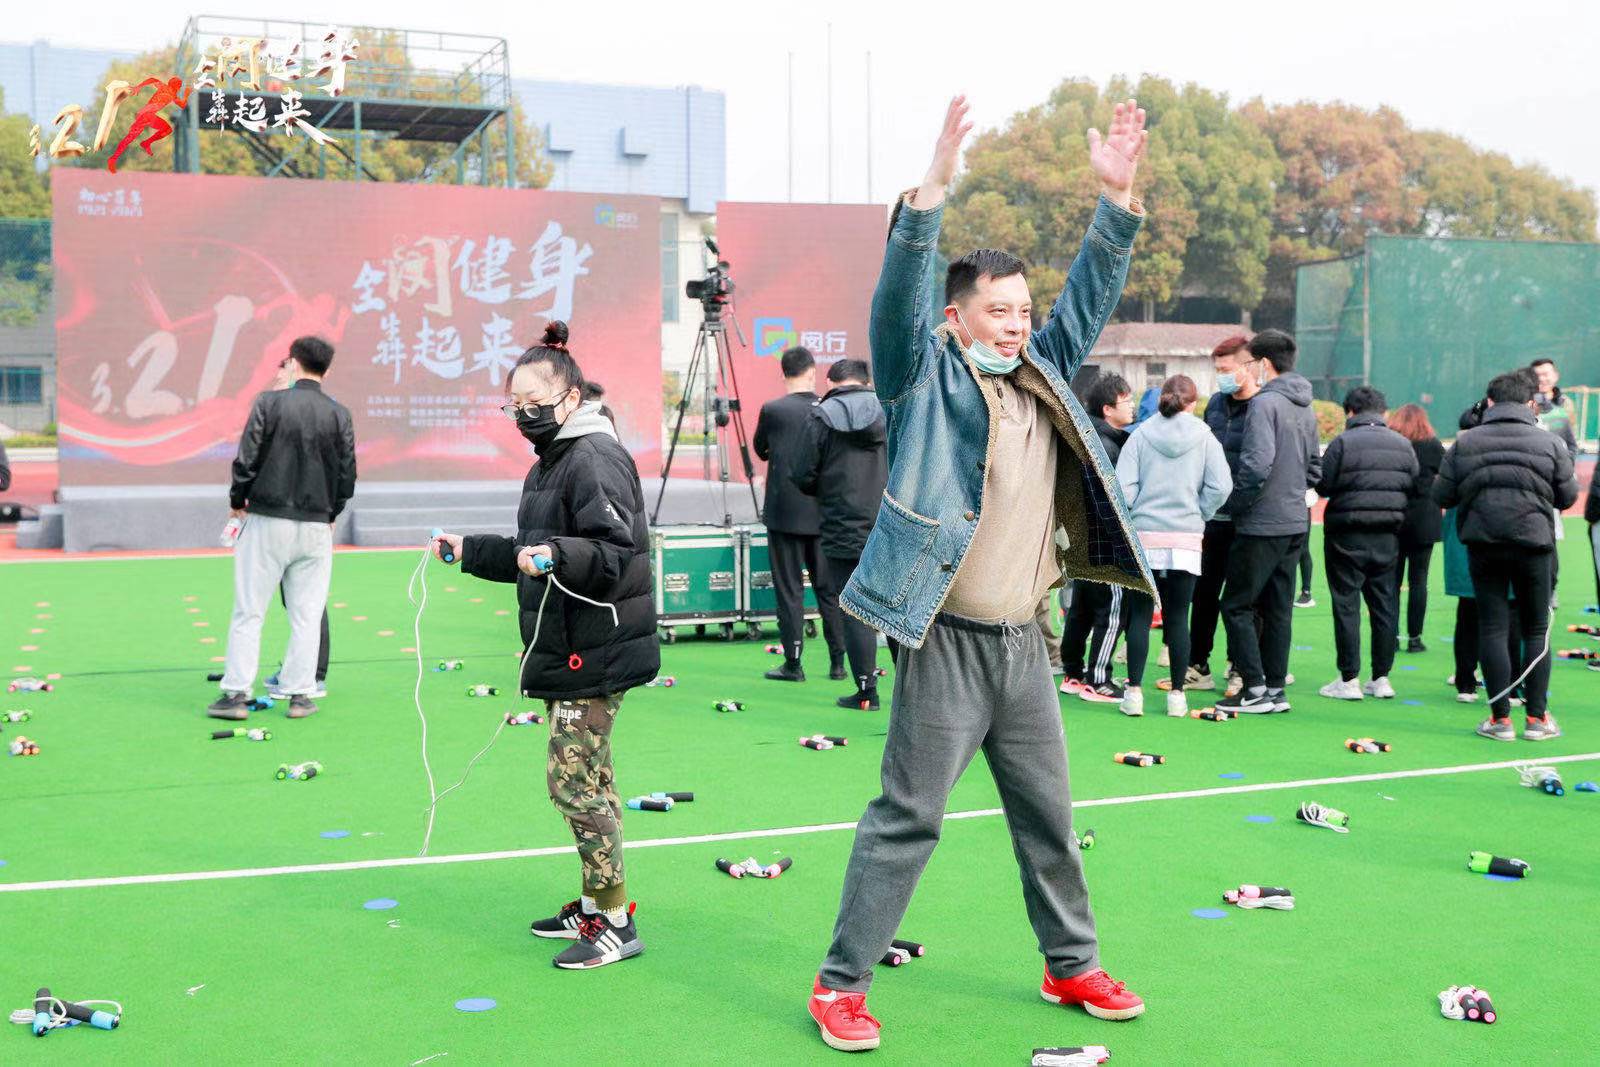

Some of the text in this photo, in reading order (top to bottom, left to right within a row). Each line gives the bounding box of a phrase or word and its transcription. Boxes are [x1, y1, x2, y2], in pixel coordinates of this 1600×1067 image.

[352, 220, 594, 322] 全闵健身
[372, 311, 528, 386] 犇起来
[801, 330, 847, 353] 闵行
